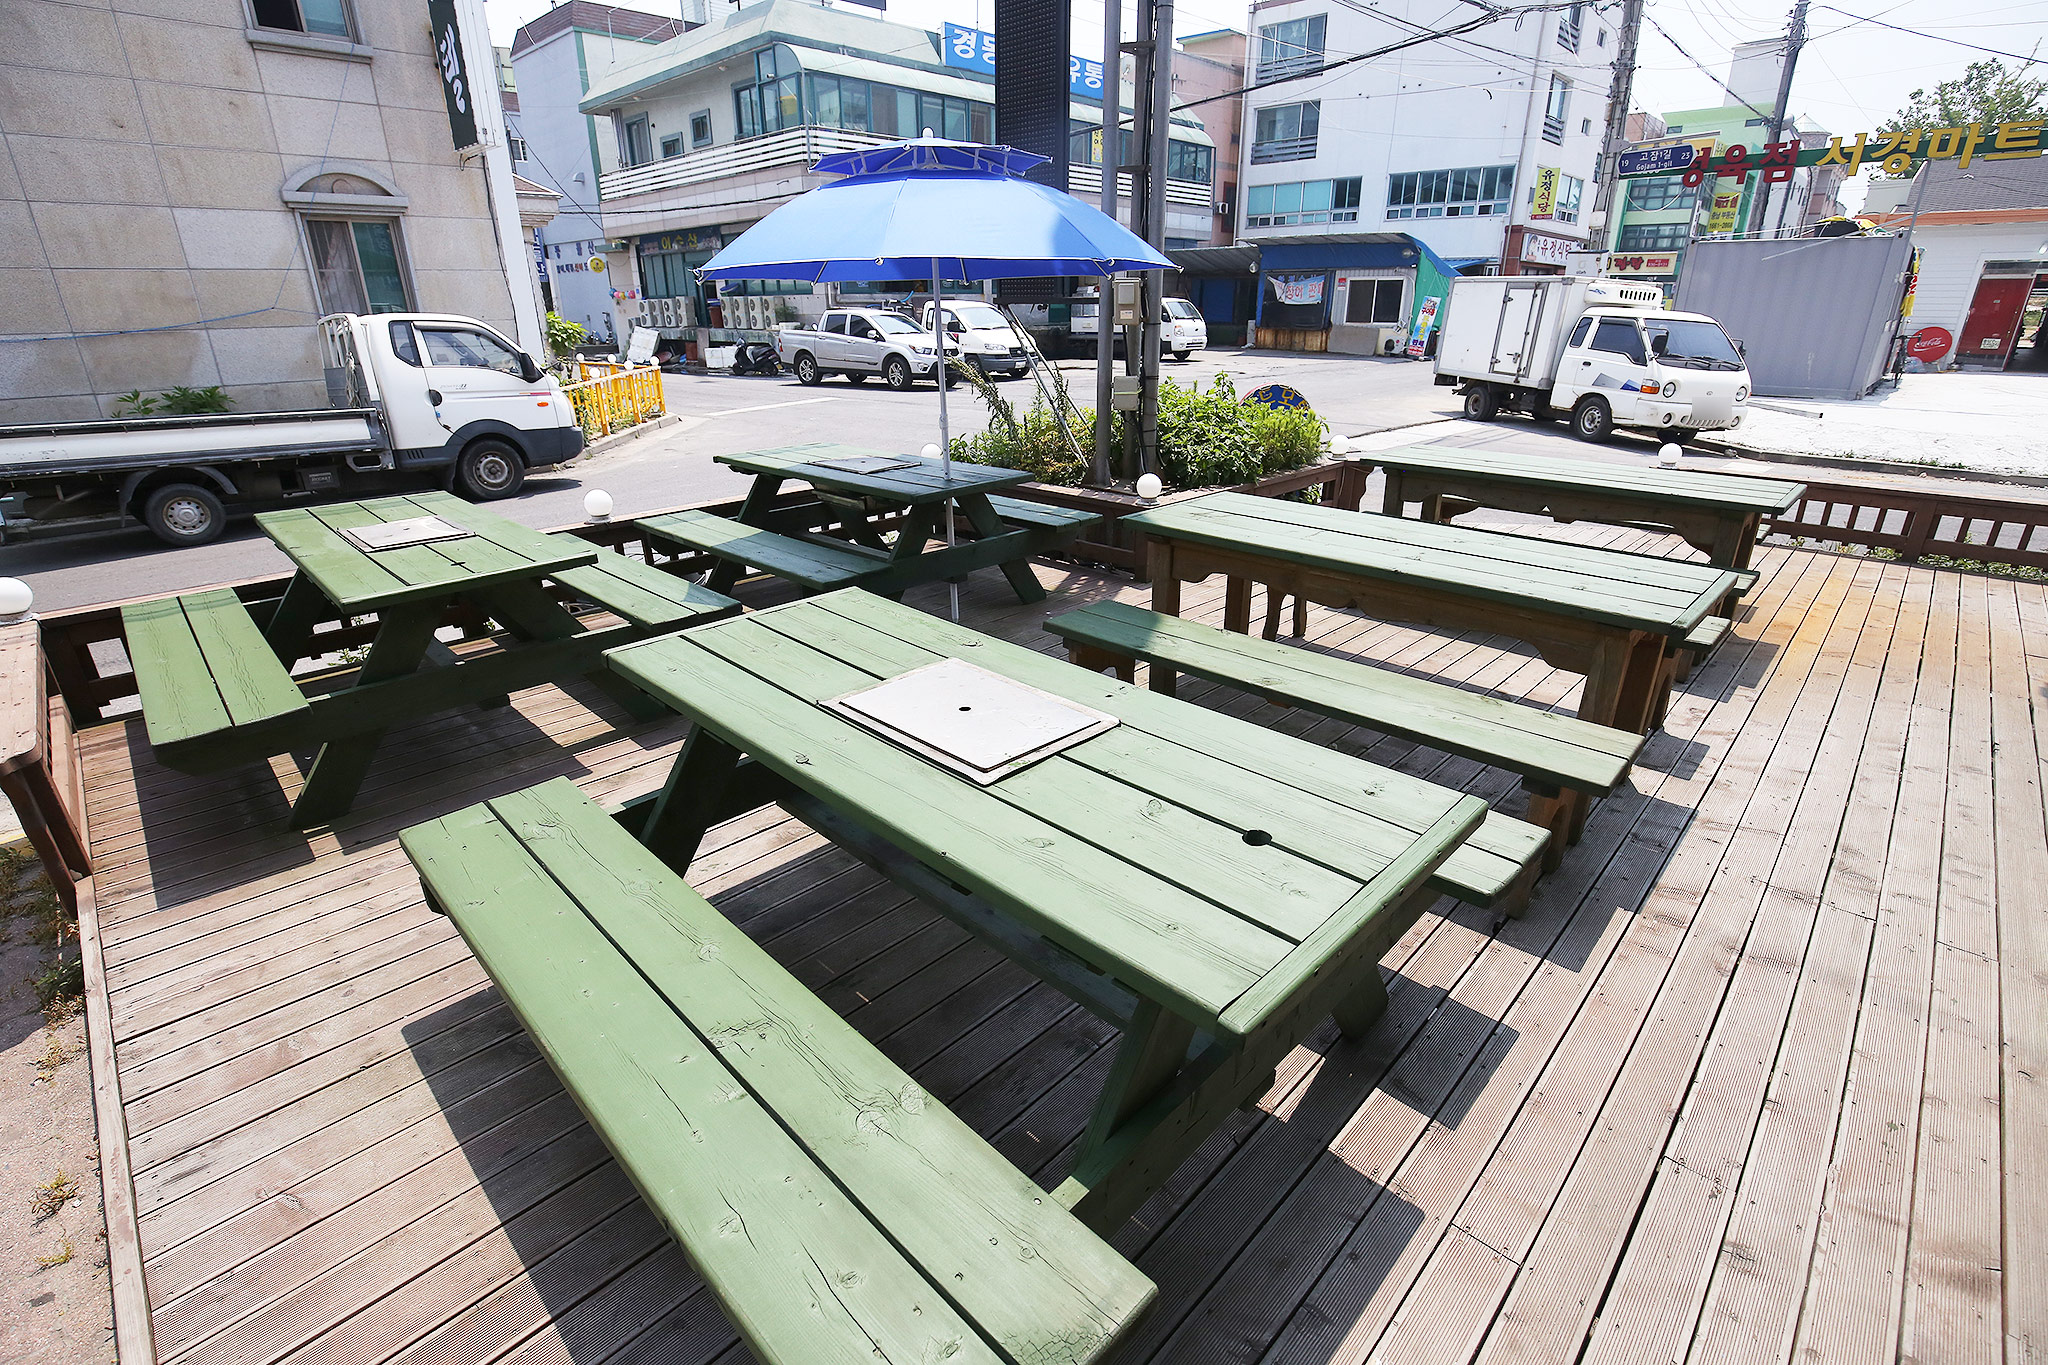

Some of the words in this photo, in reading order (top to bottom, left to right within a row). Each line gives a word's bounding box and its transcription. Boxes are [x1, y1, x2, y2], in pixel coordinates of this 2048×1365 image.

[1681, 152, 1690, 160] 23
[1815, 119, 2045, 177] 서경마트
[1636, 163, 1656, 171] Gojam
[1658, 160, 1673, 170] 1-gil
[1537, 169, 1555, 213] 유정식당
